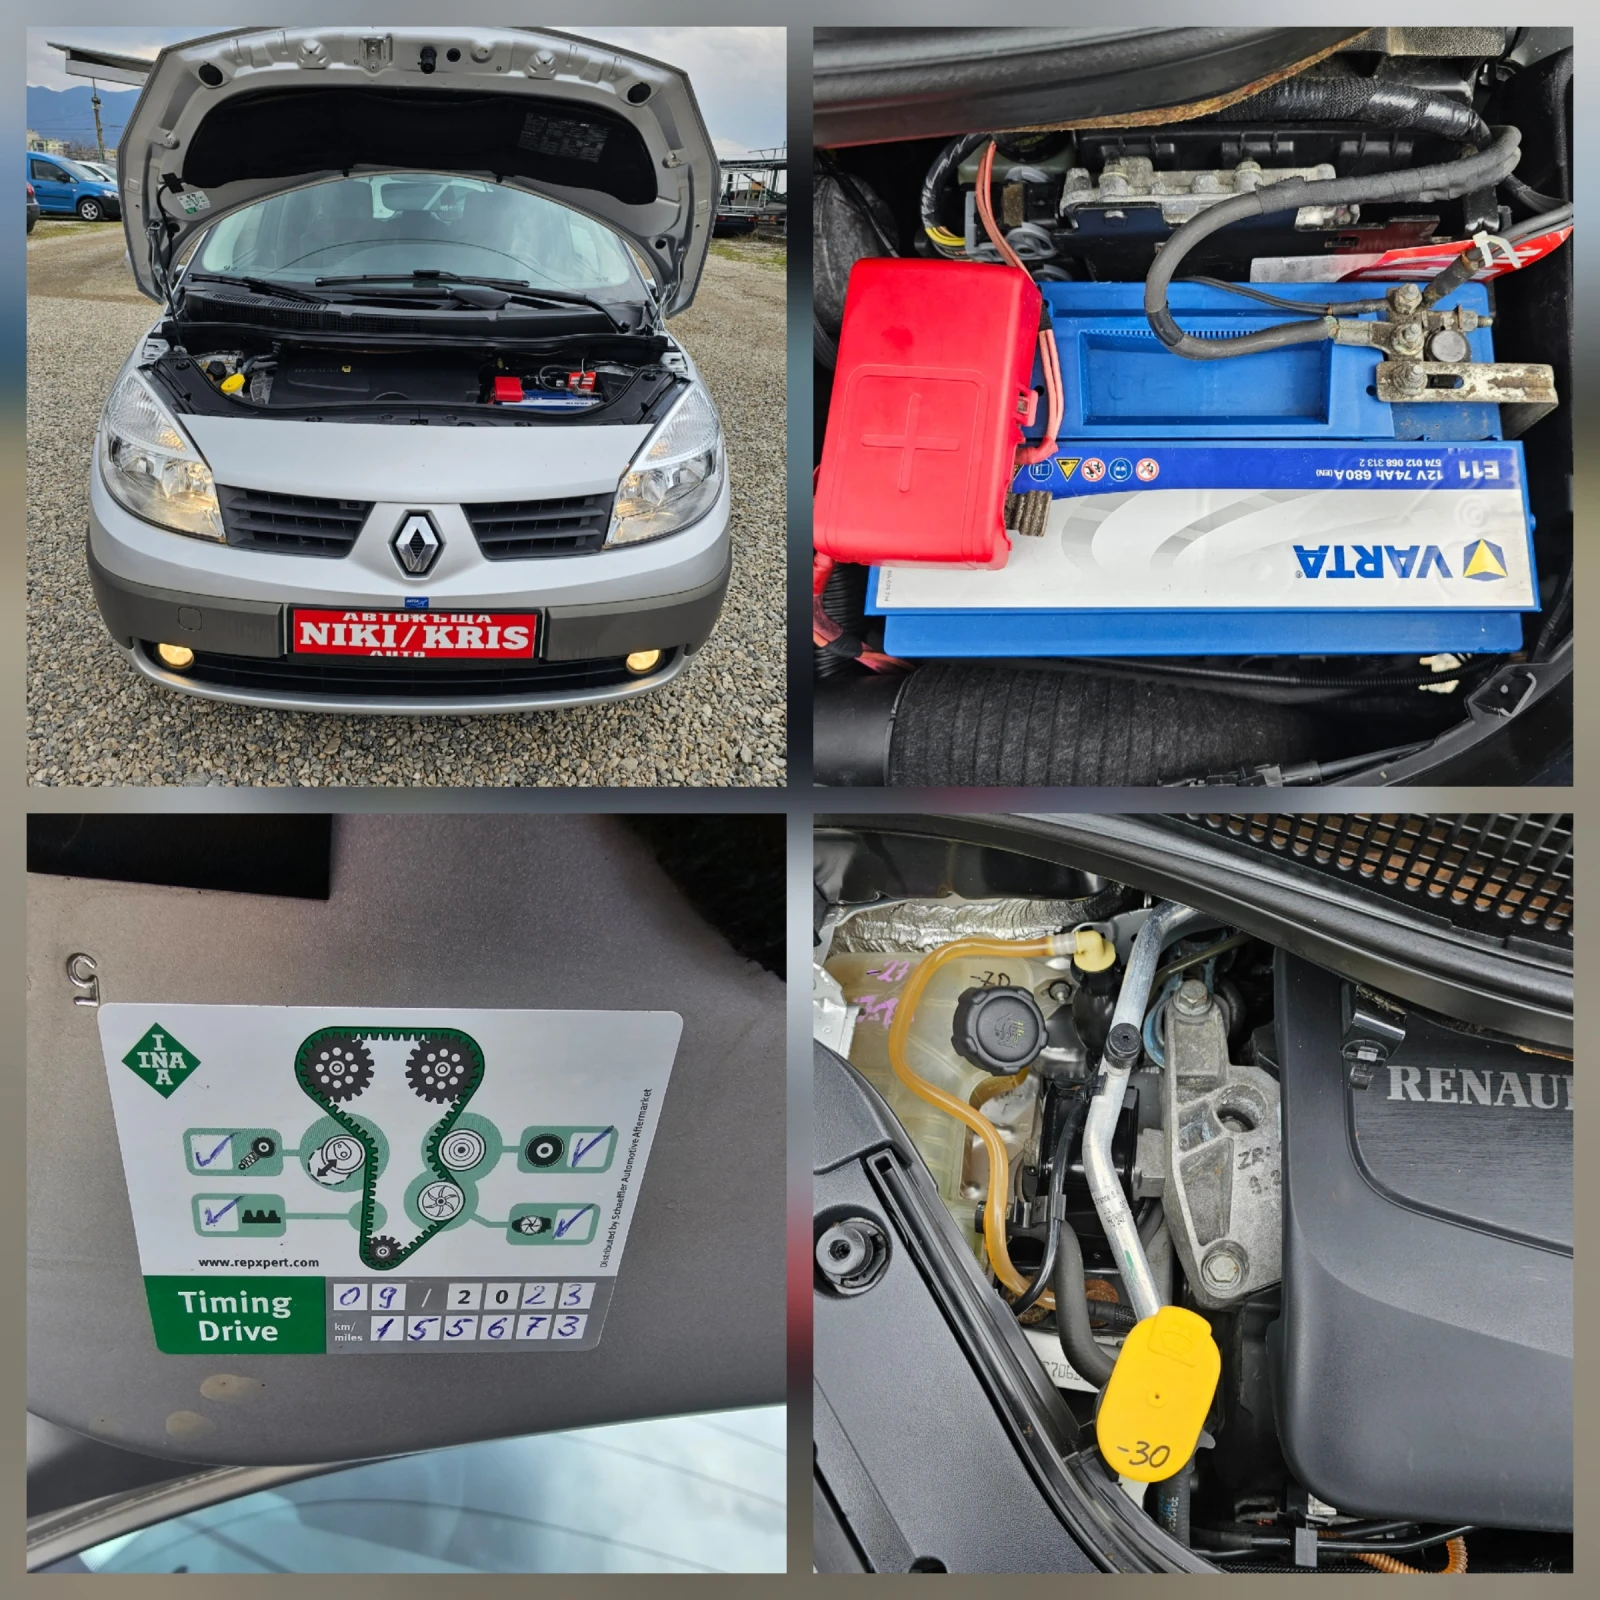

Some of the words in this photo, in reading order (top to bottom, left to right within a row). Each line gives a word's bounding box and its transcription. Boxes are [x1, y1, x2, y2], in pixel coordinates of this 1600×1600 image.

[1367, 458, 1384, 467] 313
[1386, 458, 1404, 467] 068
[1405, 458, 1423, 467] 012
[1424, 458, 1442, 467] 574
[1458, 460, 1500, 480] E11
[1416, 469, 1444, 481] 12V
[1292, 545, 1454, 579] VARTA
[299, 622, 530, 650] NIKI/KRIS
[1386, 1065, 1574, 1111] RENAU
[600, 1230, 616, 1268] Distributed
[612, 1183, 628, 1220] Schaeffler
[621, 1138, 640, 1183] Automotive
[632, 1088, 652, 1138] Aftermarket
[198, 1257, 320, 1269] www.repxpert.com
[177, 1289, 293, 1319] Timing
[198, 1319, 279, 1342] Drive
[334, 1333, 363, 1342] miles
[1117, 1440, 1171, 1468] -30
